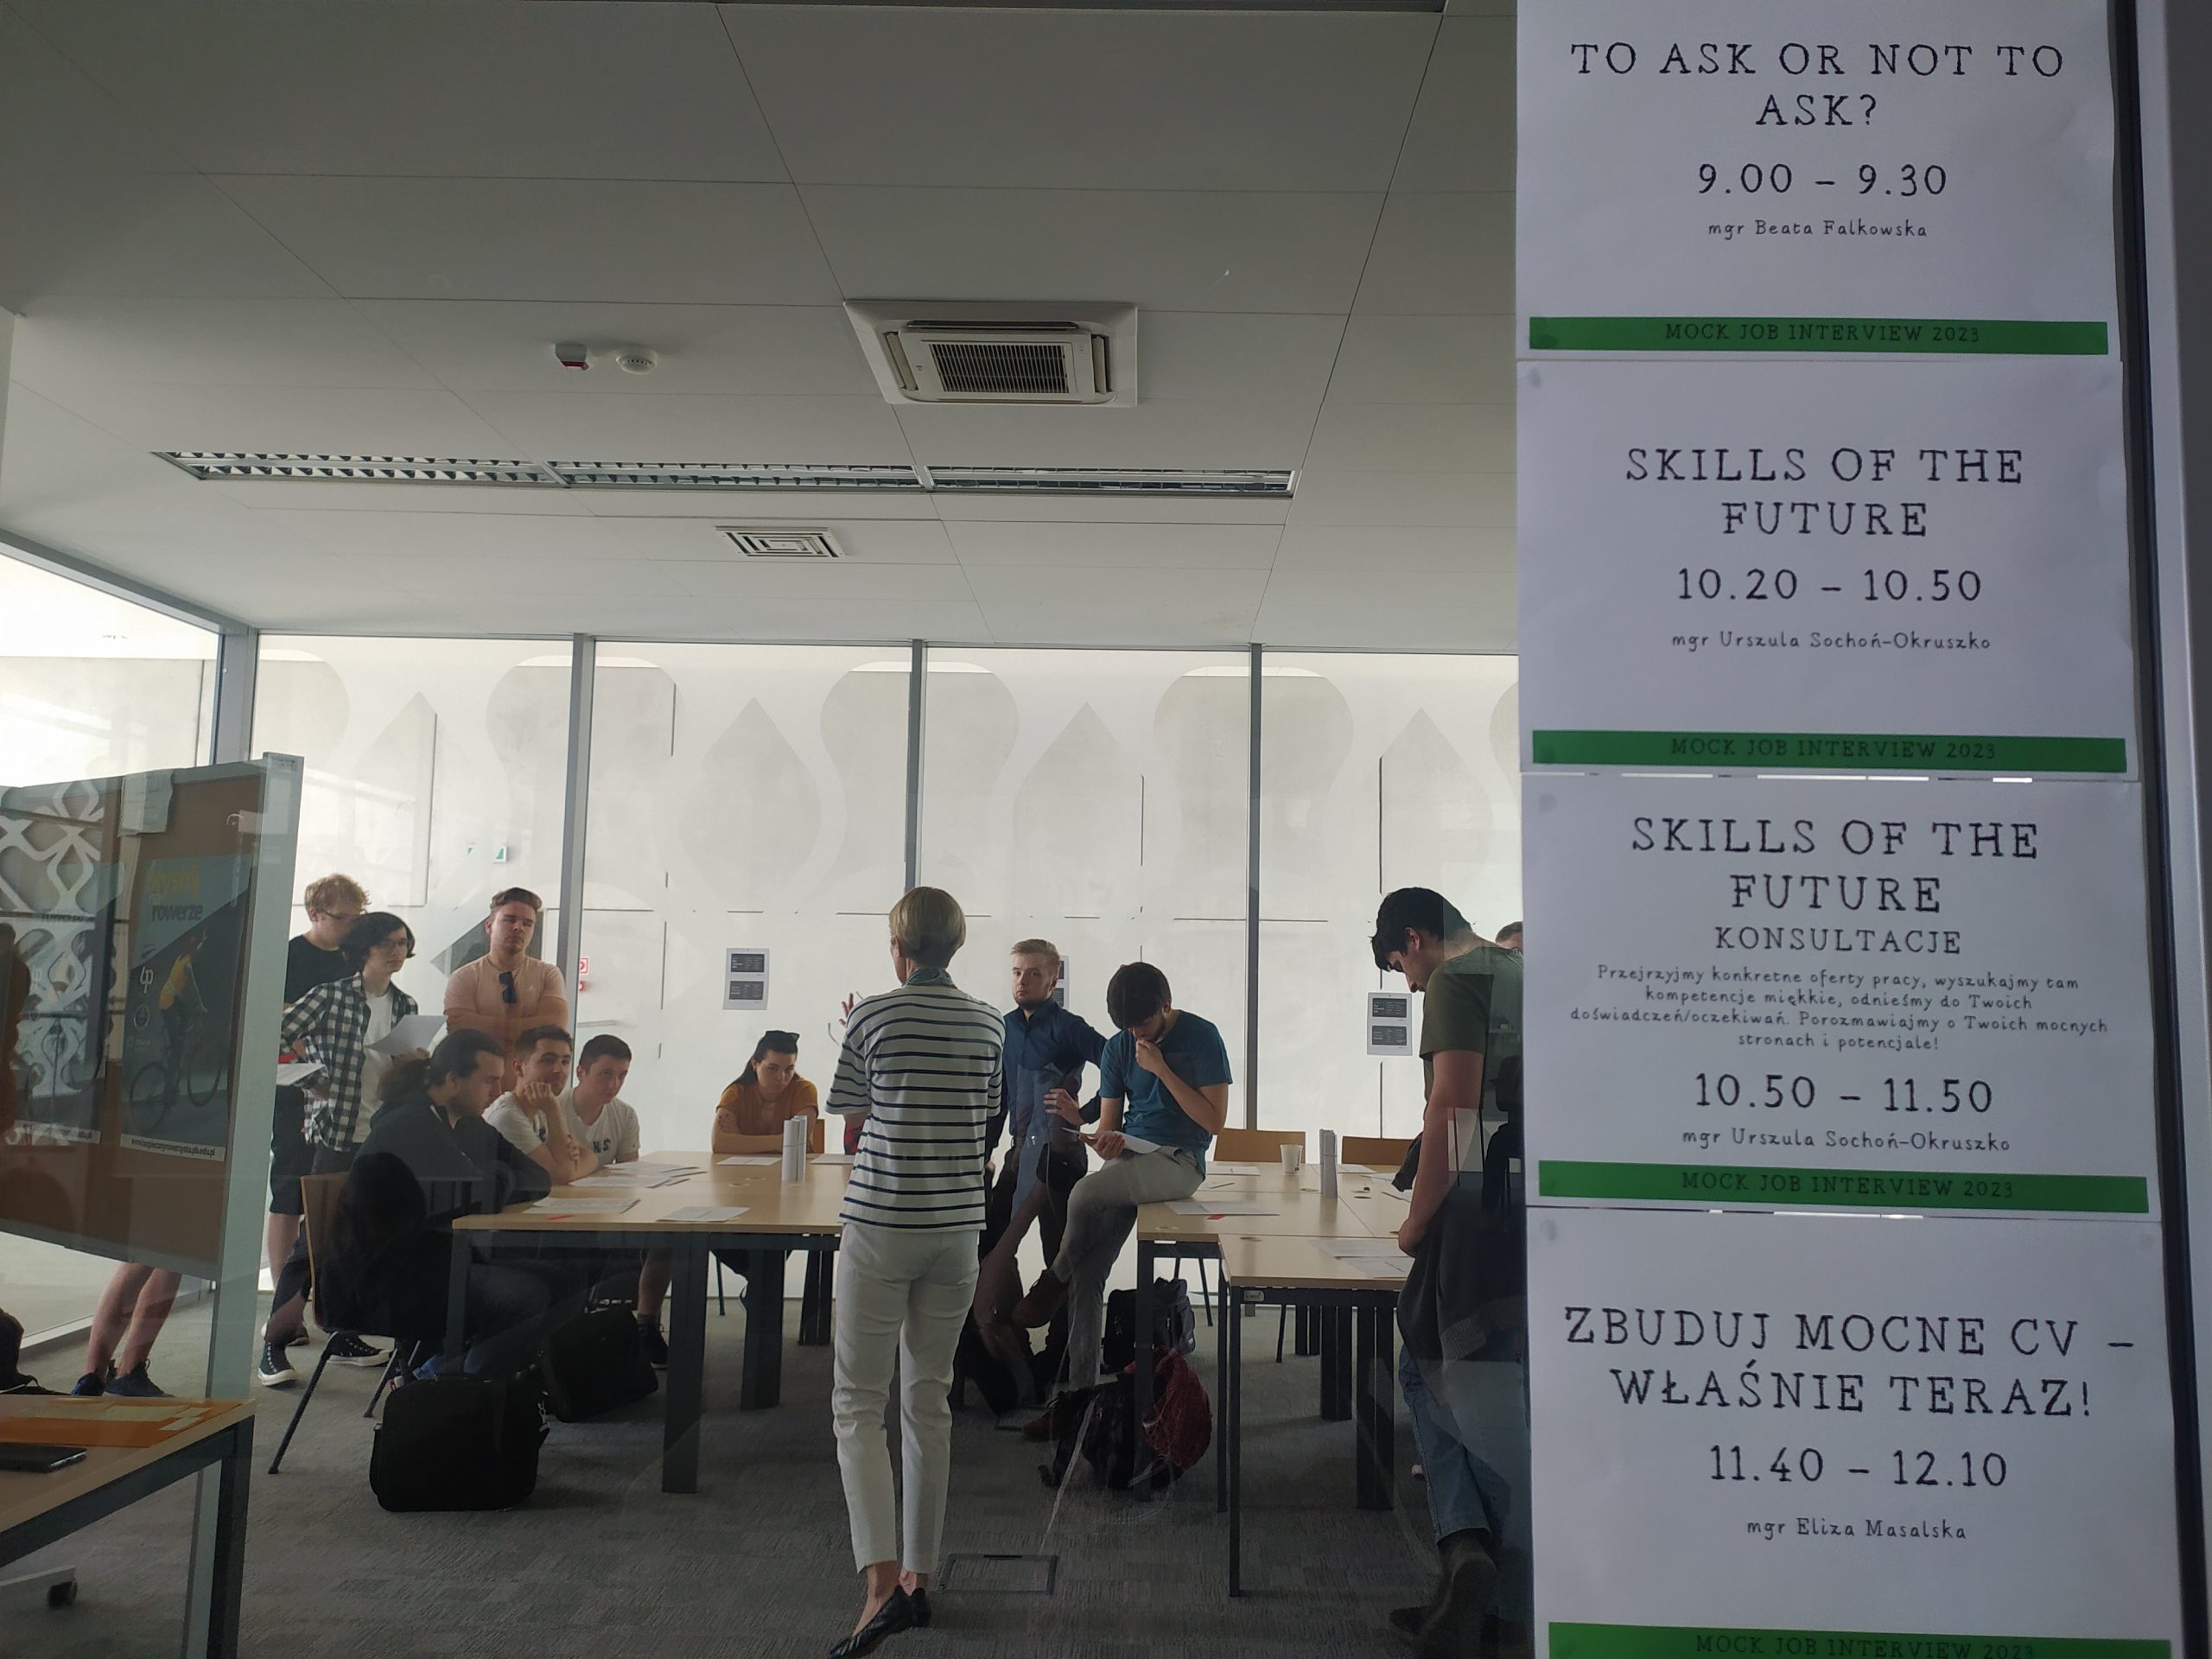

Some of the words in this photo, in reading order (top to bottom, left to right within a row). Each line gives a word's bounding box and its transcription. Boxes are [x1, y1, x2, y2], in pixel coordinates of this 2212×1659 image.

[1571, 41, 1637, 75] TO
[1659, 42, 1757, 74] ASK
[1778, 42, 1846, 75] OR
[1868, 43, 1973, 77] NOT
[1996, 44, 2063, 78] TO
[1755, 93, 1877, 126] ASK?
[1699, 162, 1792, 194] 9.00
[1859, 163, 1947, 197] 9.30
[1708, 223, 1745, 241] mgr
[1754, 219, 1813, 235] Beata
[1822, 217, 1927, 237] Falkowska
[1665, 323, 1730, 340] MOCK
[1739, 323, 1779, 340] JOB
[1788, 323, 1923, 342] INTERVIEW
[1932, 326, 1980, 343] 2023
[1626, 448, 1806, 481] SKILLS
[1831, 447, 1896, 482] OF
[1919, 448, 2023, 485] THE
[1721, 500, 1927, 537] FUTURE
[1679, 568, 1798, 601] 10.20
[1864, 569, 1981, 601] 10.50
[1672, 634, 1709, 653] mgr
[1719, 630, 1800, 647] Urszula
[1810, 630, 1991, 650] Sochoń-Okruszko
[1671, 739, 1736, 755] MOCK
[1746, 739, 1788, 757] JOB
[1797, 740, 1936, 759] INTERVIEW
[1946, 742, 1996, 760] 2023
[1632, 817, 1815, 854] SKILLS
[1840, 819, 1907, 855] OF
[1931, 822, 2037, 860] THE
[1730, 873, 1941, 913] FUTURE
[151, 904, 204, 922] rowerze
[1714, 925, 1961, 955] KONSULTACJE
[1598, 964, 1705, 983] Przejrzyjmy
[1712, 965, 1802, 982] konkretne
[1809, 969, 1865, 989] oferty
[1872, 976, 1927, 992] pracy,
[1935, 972, 2039, 994] wyszukajmy
[2046, 977, 2079, 989] tam
[1646, 988, 1757, 1007] kompetencje
[1765, 988, 1842, 1008] miękkie,
[1851, 993, 1933, 1014] odnieśmy
[1941, 995, 1961, 1008] do
[1969, 994, 2033, 1009] Twoich
[1571, 1008, 1790, 1025] doświadczeń/oczekiwań.
[1800, 1011, 1940, 1032] Porozmawiajmy
[1947, 1019, 1956, 1029] o
[1964, 1015, 2028, 1031] Twoich
[2036, 1018, 2107, 1037] mocnych
[1738, 1032, 1815, 1047] stronach
[1823, 1033, 1830, 1047] i
[1838, 1033, 1938, 1052] potencjale!
[1696, 1072, 1815, 1109] 10.50
[1884, 1077, 1993, 1113] 11.50
[1682, 1131, 1721, 1150] mgr
[1732, 1127, 1815, 1147] Urszula
[1825, 1130, 2010, 1152] Sochoń-Okruszko
[1681, 1172, 1750, 1191] MOCK
[1759, 1174, 1802, 1192] JOB
[1811, 1175, 1954, 1197] INTERVIEW
[1963, 1180, 2013, 1198] 2023
[1565, 1306, 1770, 1350] ZBUDUJ
[1795, 1313, 1985, 1357] MOCNE
[2011, 1318, 2079, 1357] CV
[1609, 1358, 1864, 1413] WŁAŚNIE
[1889, 1375, 2090, 1417] TERAZ!
[1710, 1445, 1824, 1483] 11.40
[1893, 1449, 2007, 1487] 12.10
[1747, 1521, 1786, 1541] mgr
[1796, 1517, 1855, 1536] Eliza
[1865, 1518, 1967, 1540] Masalska
[1695, 1634, 1765, 1654] MOCK
[1775, 1637, 1818, 1656] JOB
[1827, 1638, 1973, 1659] INTERVIEW
